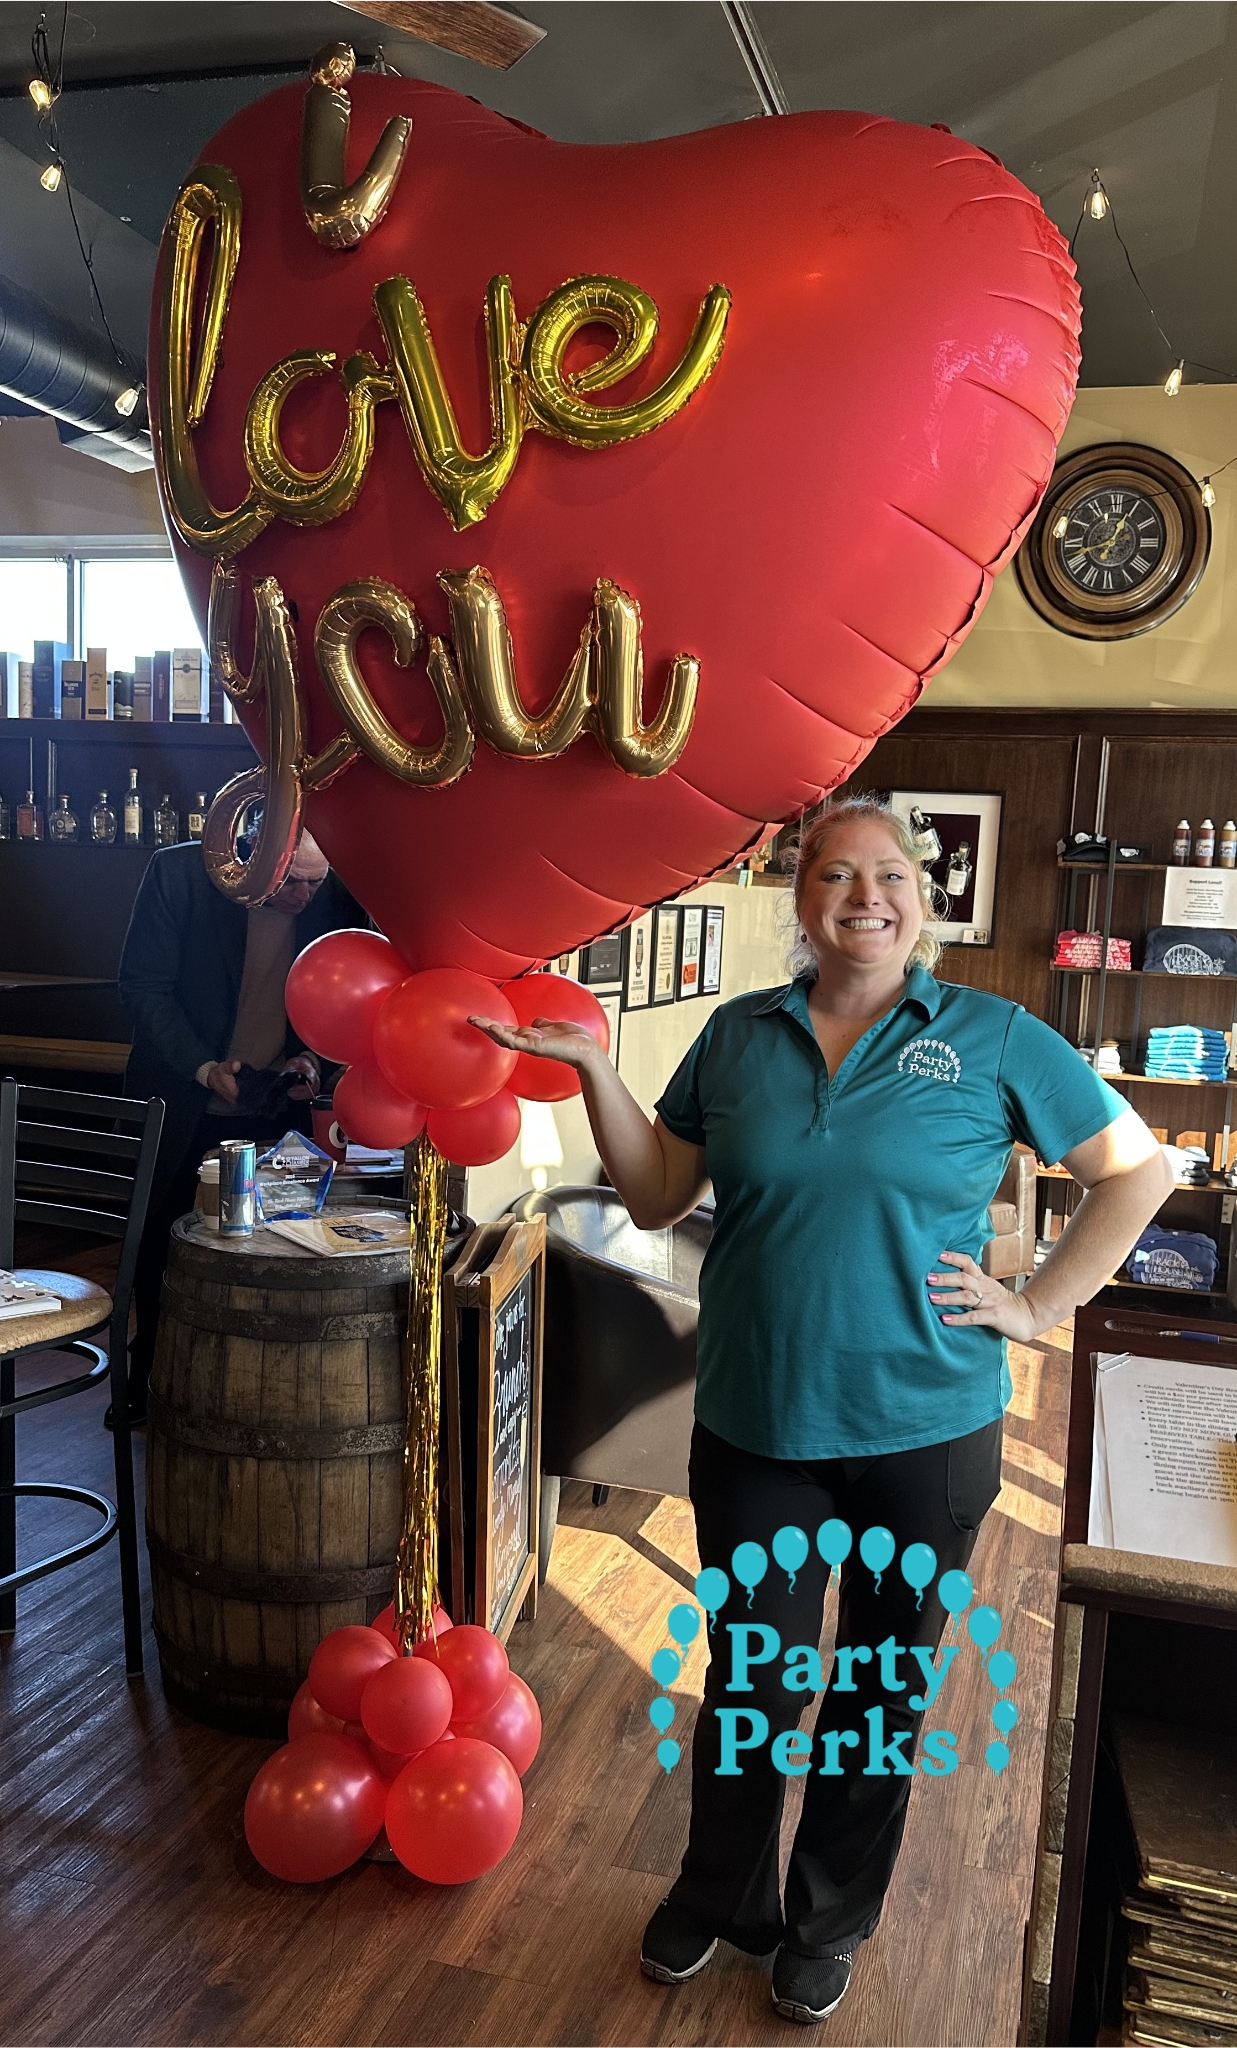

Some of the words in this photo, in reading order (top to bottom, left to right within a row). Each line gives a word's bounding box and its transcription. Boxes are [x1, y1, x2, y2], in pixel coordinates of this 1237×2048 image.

[302, 41, 412, 249] i
[151, 163, 734, 561] love
[1140, 535, 1159, 549] III
[203, 554, 700, 909] you
[908, 1063, 950, 1082] Perks
[912, 1051, 953, 1072] Party
